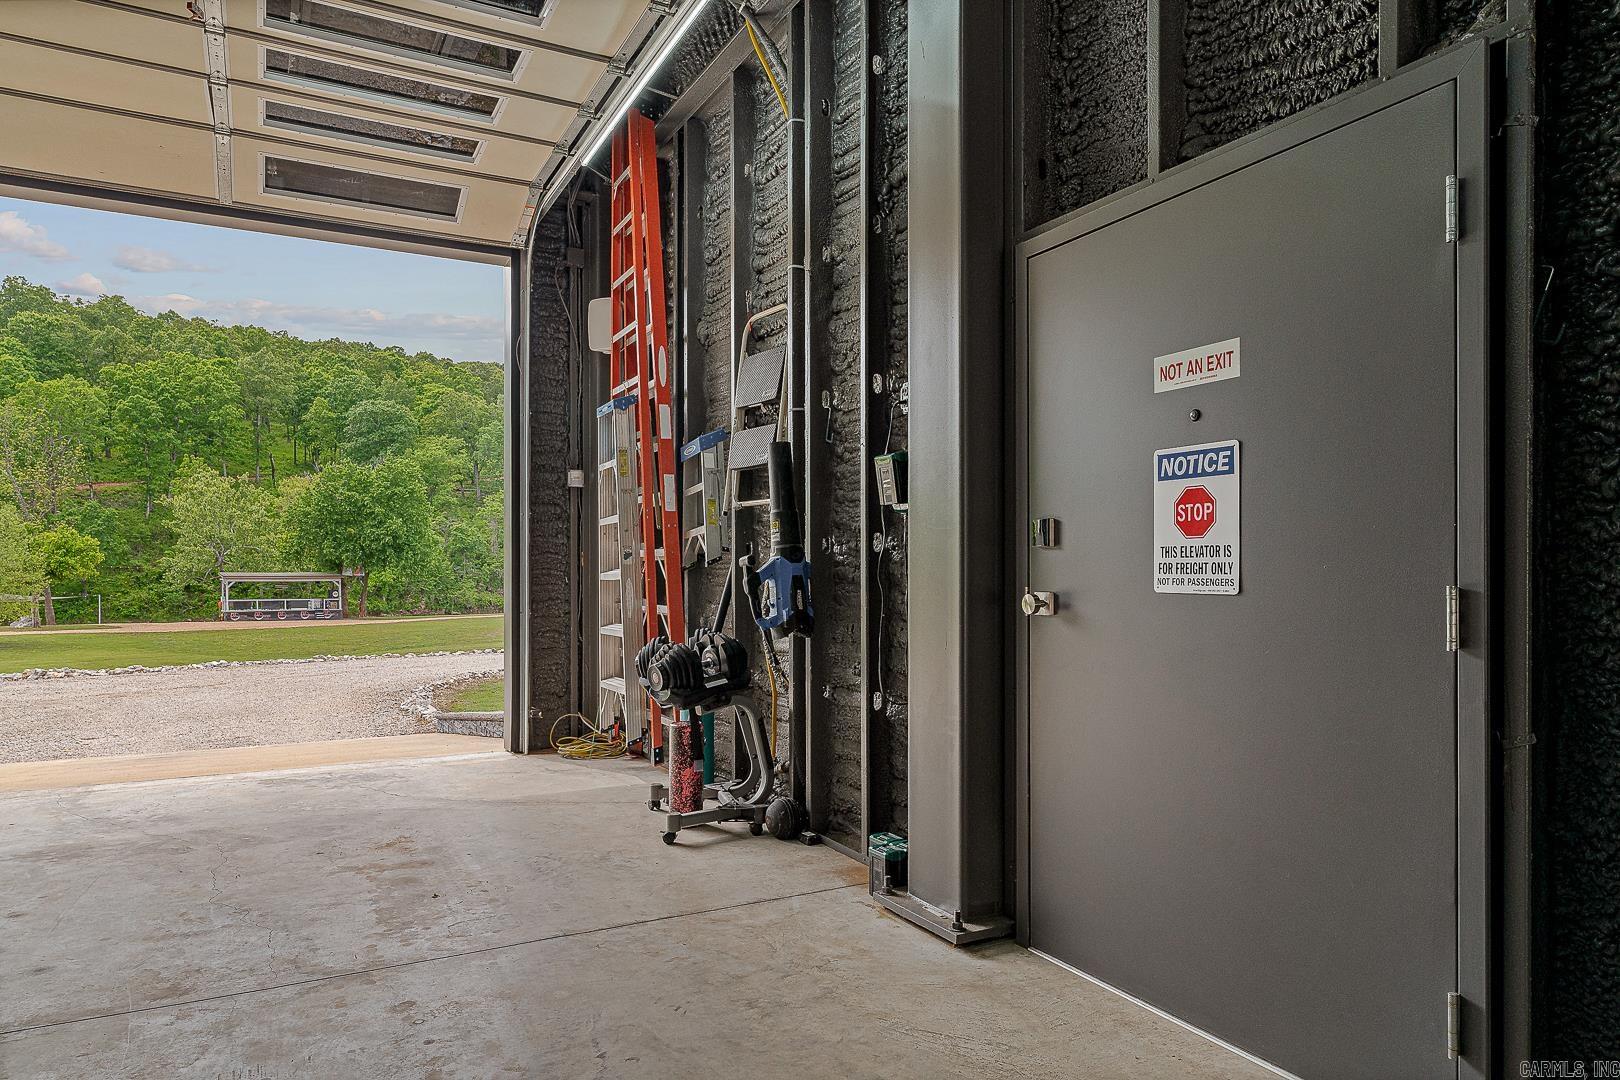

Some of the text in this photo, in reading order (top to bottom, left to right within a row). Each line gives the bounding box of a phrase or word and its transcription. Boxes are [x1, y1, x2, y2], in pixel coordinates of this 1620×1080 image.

[1160, 362, 1183, 382] NOT
[1186, 357, 1203, 376] AN
[1207, 350, 1234, 372] EXIT
[1160, 450, 1231, 477] NOTICE
[1177, 502, 1213, 522] STOP
[1160, 544, 1232, 559] THIS ELEVATOR IS
[1158, 561, 1234, 575] FOR FREIGHT ONLY
[1157, 577, 1235, 587] NOT FOR PASSENGERS
